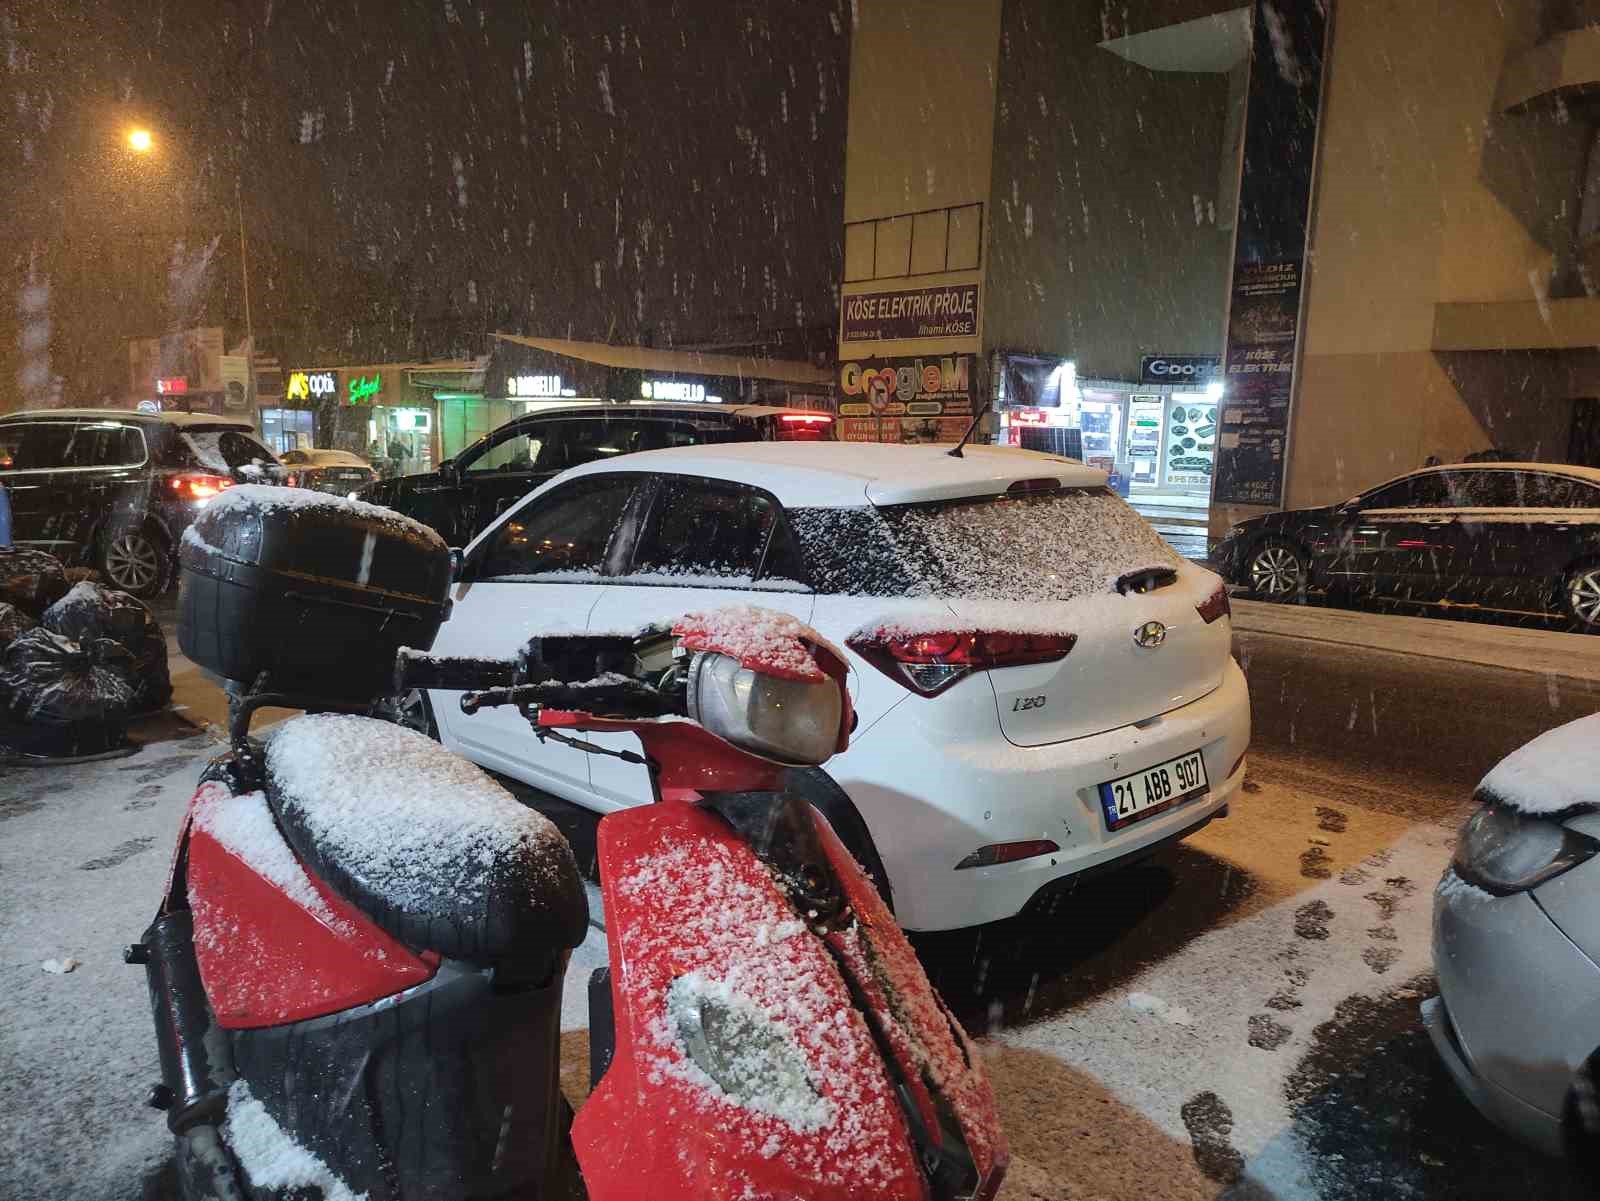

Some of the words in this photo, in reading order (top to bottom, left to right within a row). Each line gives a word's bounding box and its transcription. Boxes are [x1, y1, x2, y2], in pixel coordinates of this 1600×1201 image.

[846, 295, 876, 320] KÖSE
[878, 289, 933, 319] ELEKTRİK
[933, 290, 974, 315] PROJE
[945, 319, 971, 333] KÖSE
[1115, 781, 1136, 815] 21
[1144, 769, 1172, 804] ABB
[1176, 756, 1200, 790] 907
